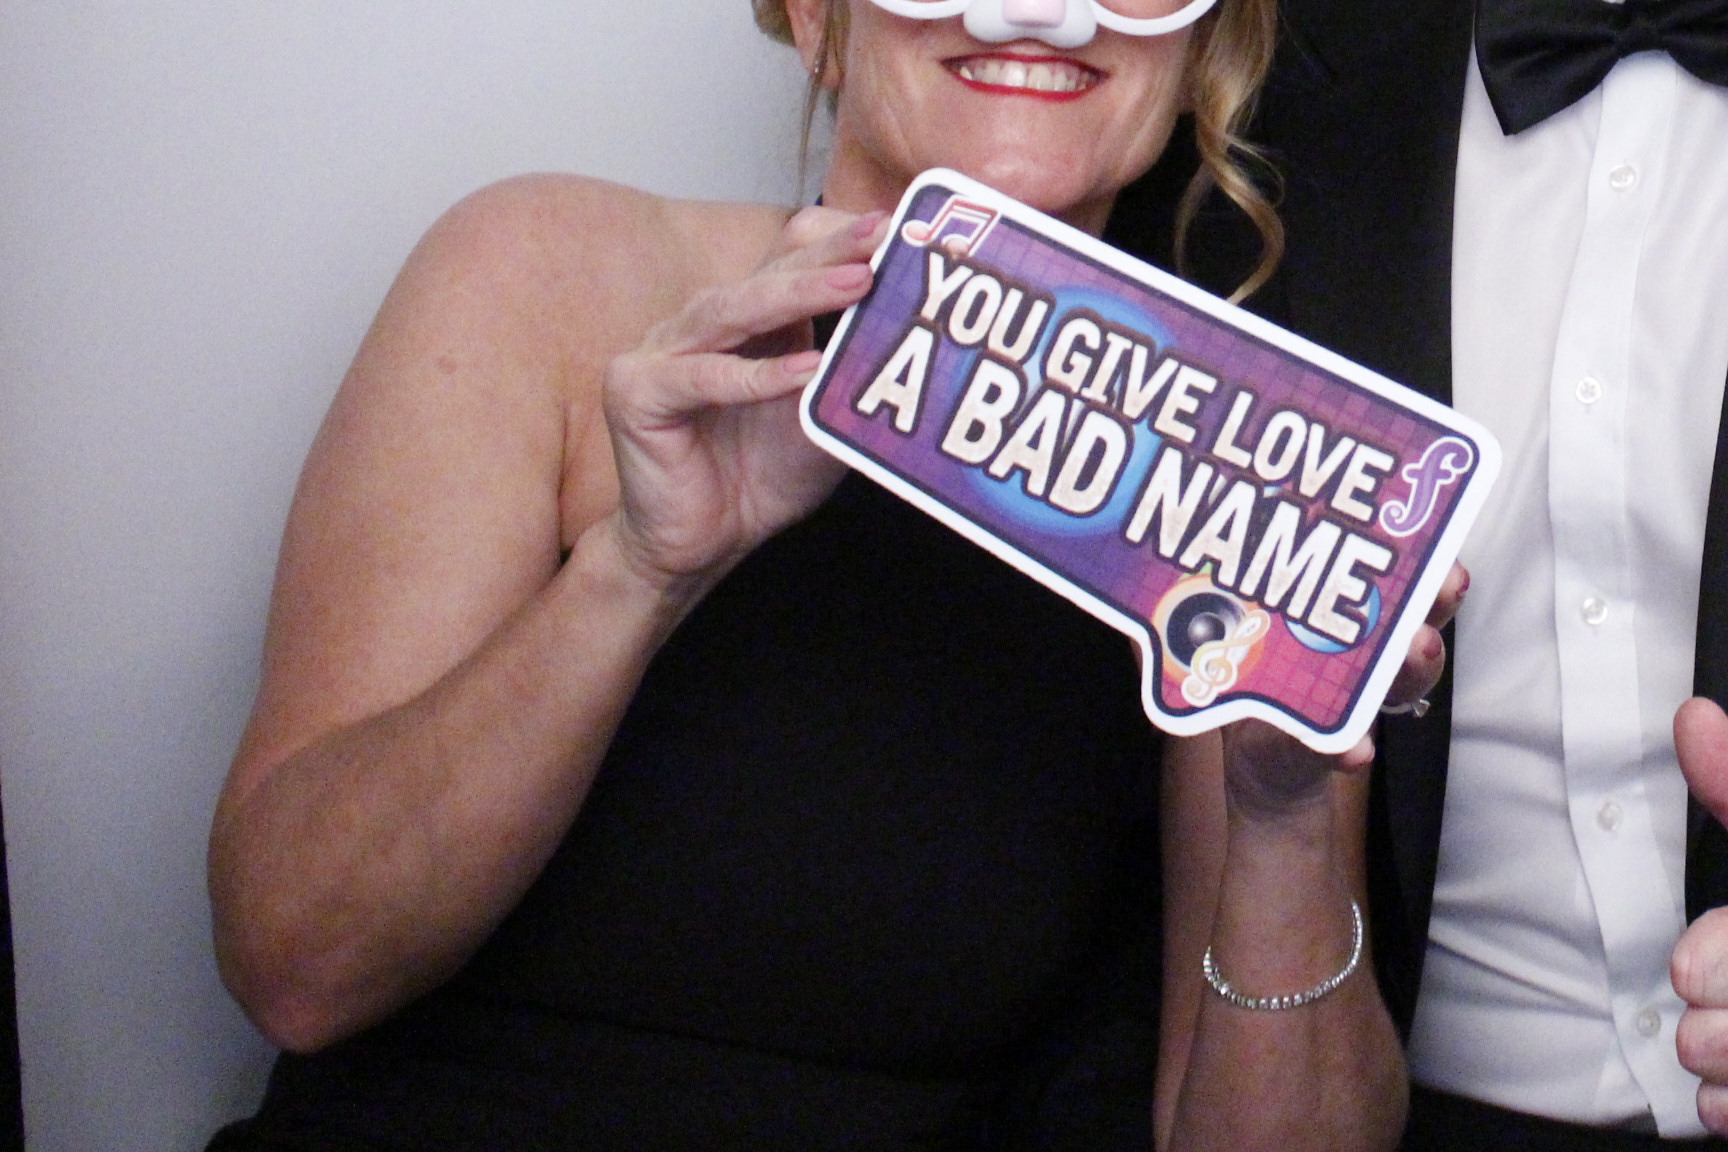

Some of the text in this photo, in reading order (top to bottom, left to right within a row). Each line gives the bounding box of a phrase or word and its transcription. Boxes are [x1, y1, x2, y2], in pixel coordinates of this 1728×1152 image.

[857, 326, 1393, 644] A BAD NAME
[921, 252, 1394, 522] YOU GIVE LOVE
